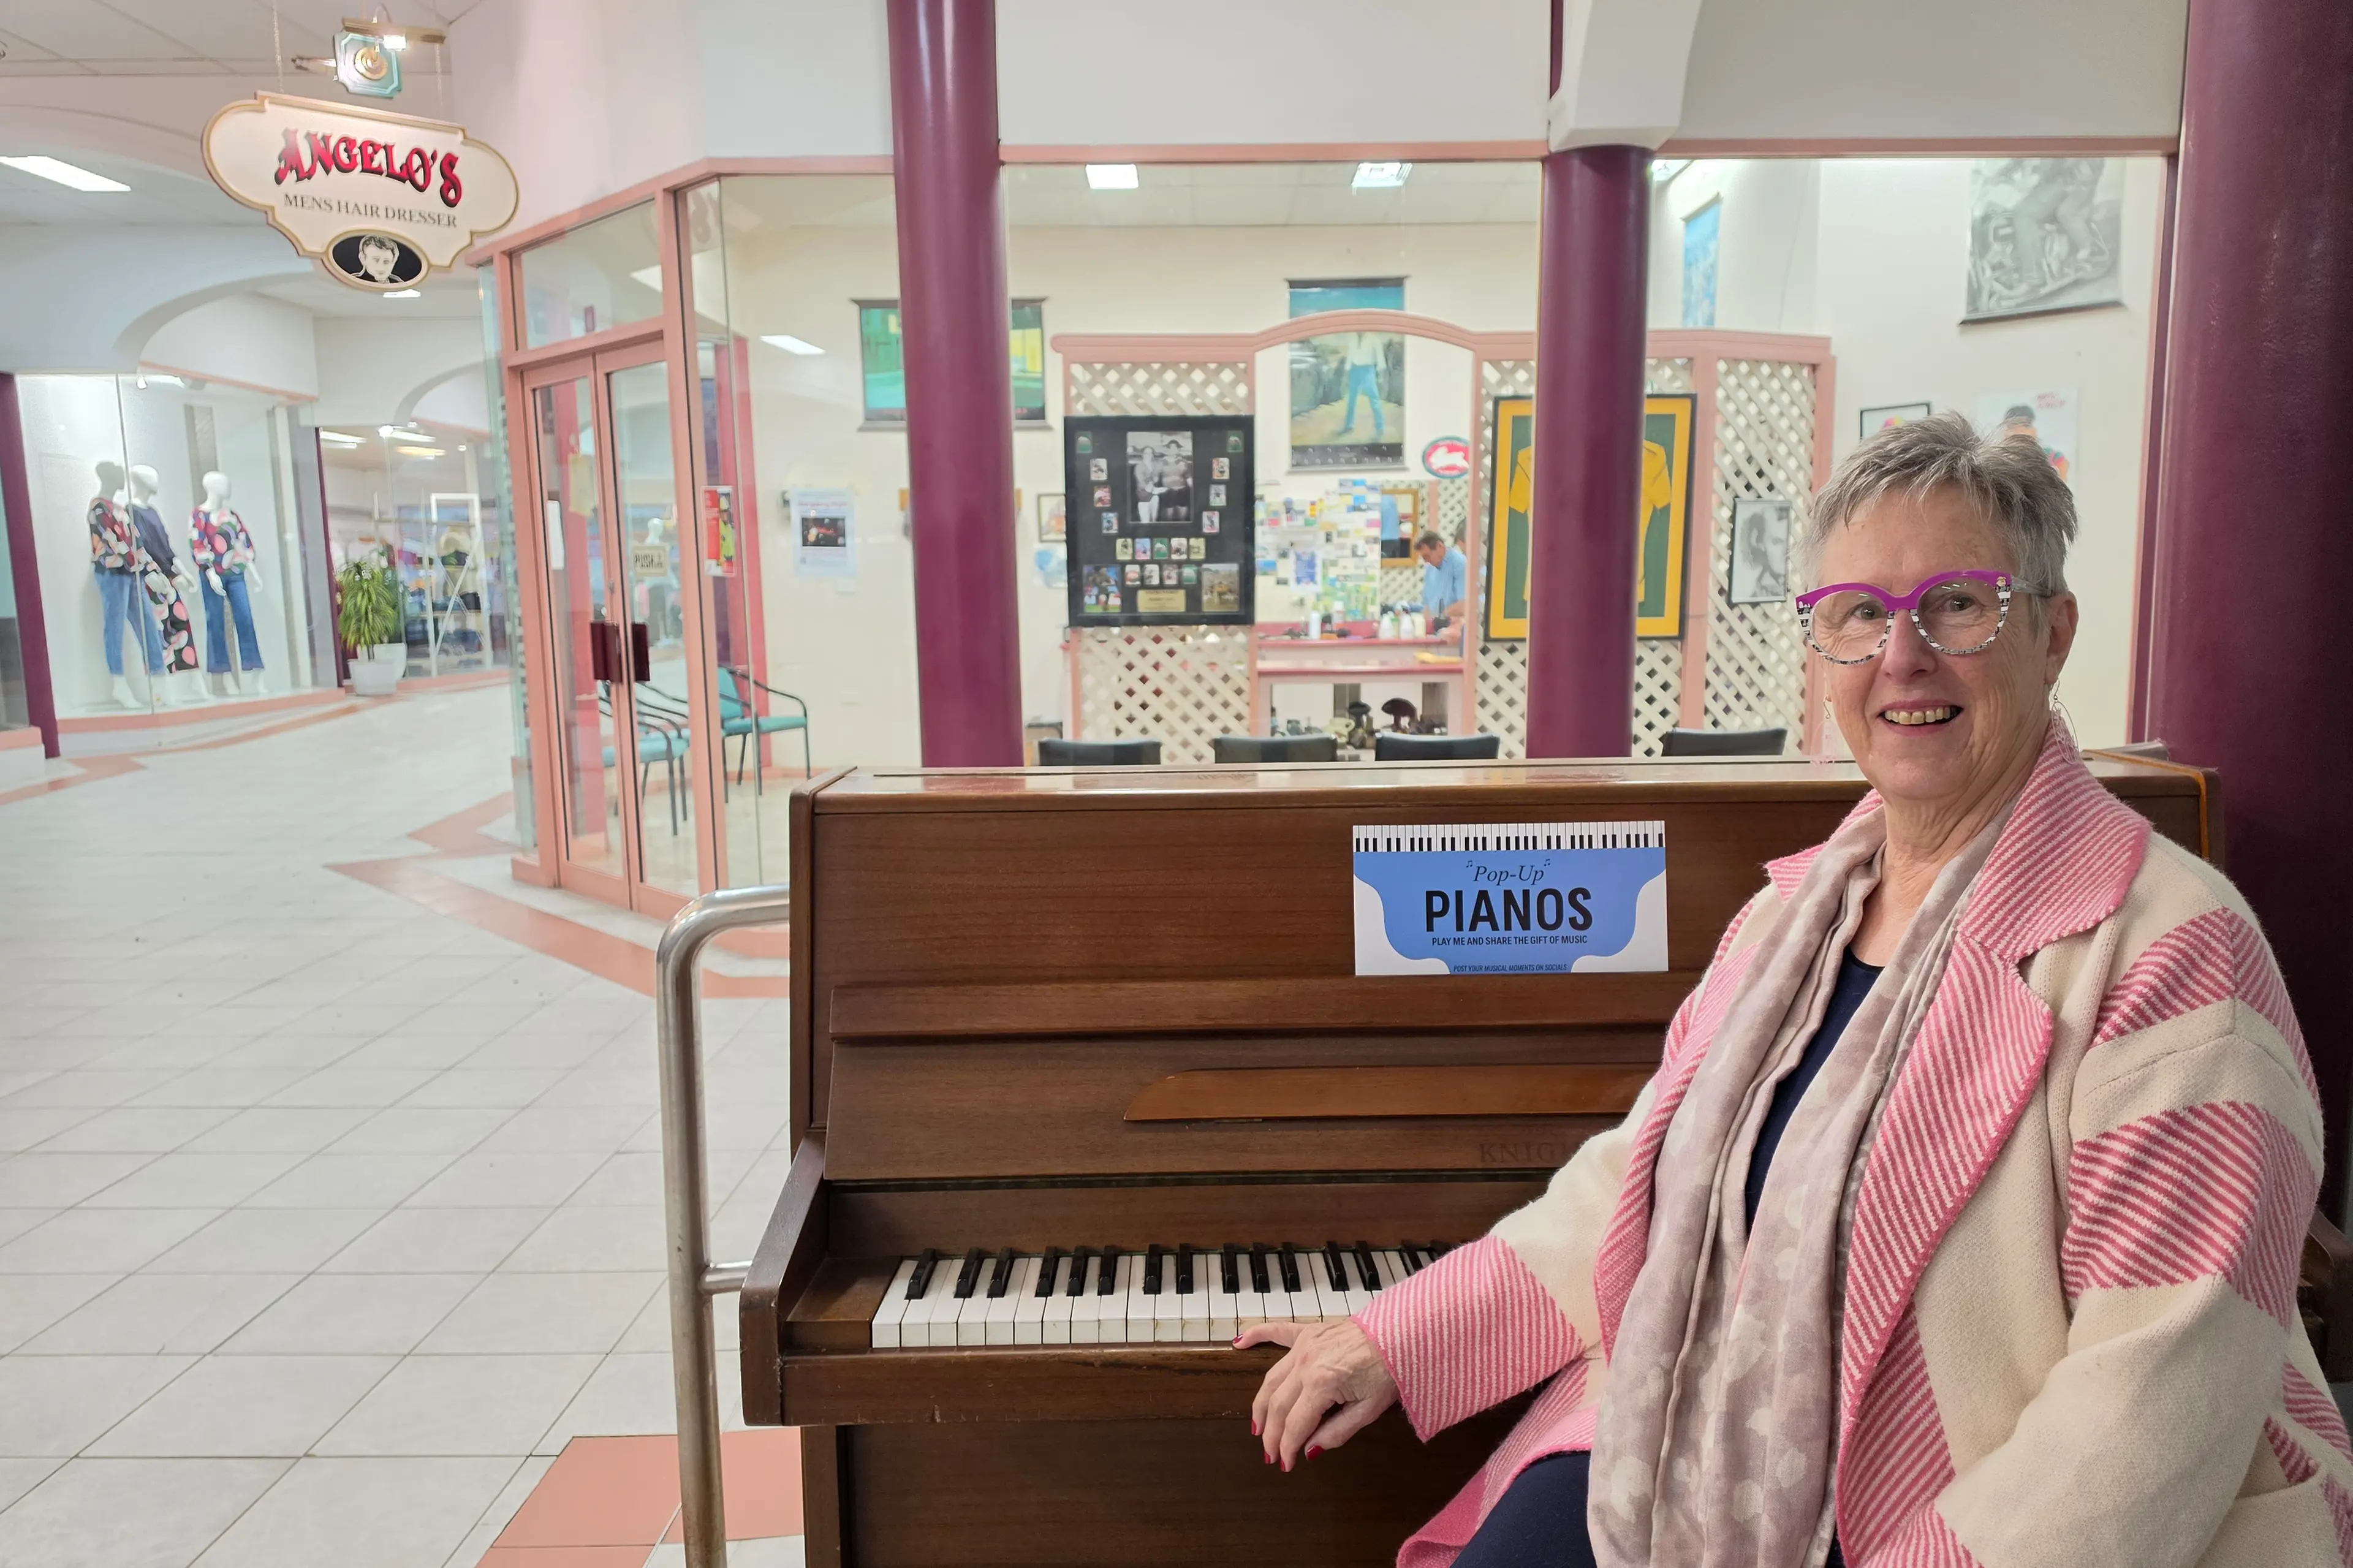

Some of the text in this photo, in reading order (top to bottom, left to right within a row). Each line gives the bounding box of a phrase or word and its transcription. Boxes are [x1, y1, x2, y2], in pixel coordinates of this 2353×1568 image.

[275, 127, 463, 208] ANGELO'S
[284, 193, 457, 229] MENS HAIR DRESSER
[1473, 864, 1544, 886] Pop-Up
[1425, 887, 1593, 933] PIANOS
[1432, 935, 1588, 946] PLAY ME AND SHARE THE GIFT OF MUSIC
